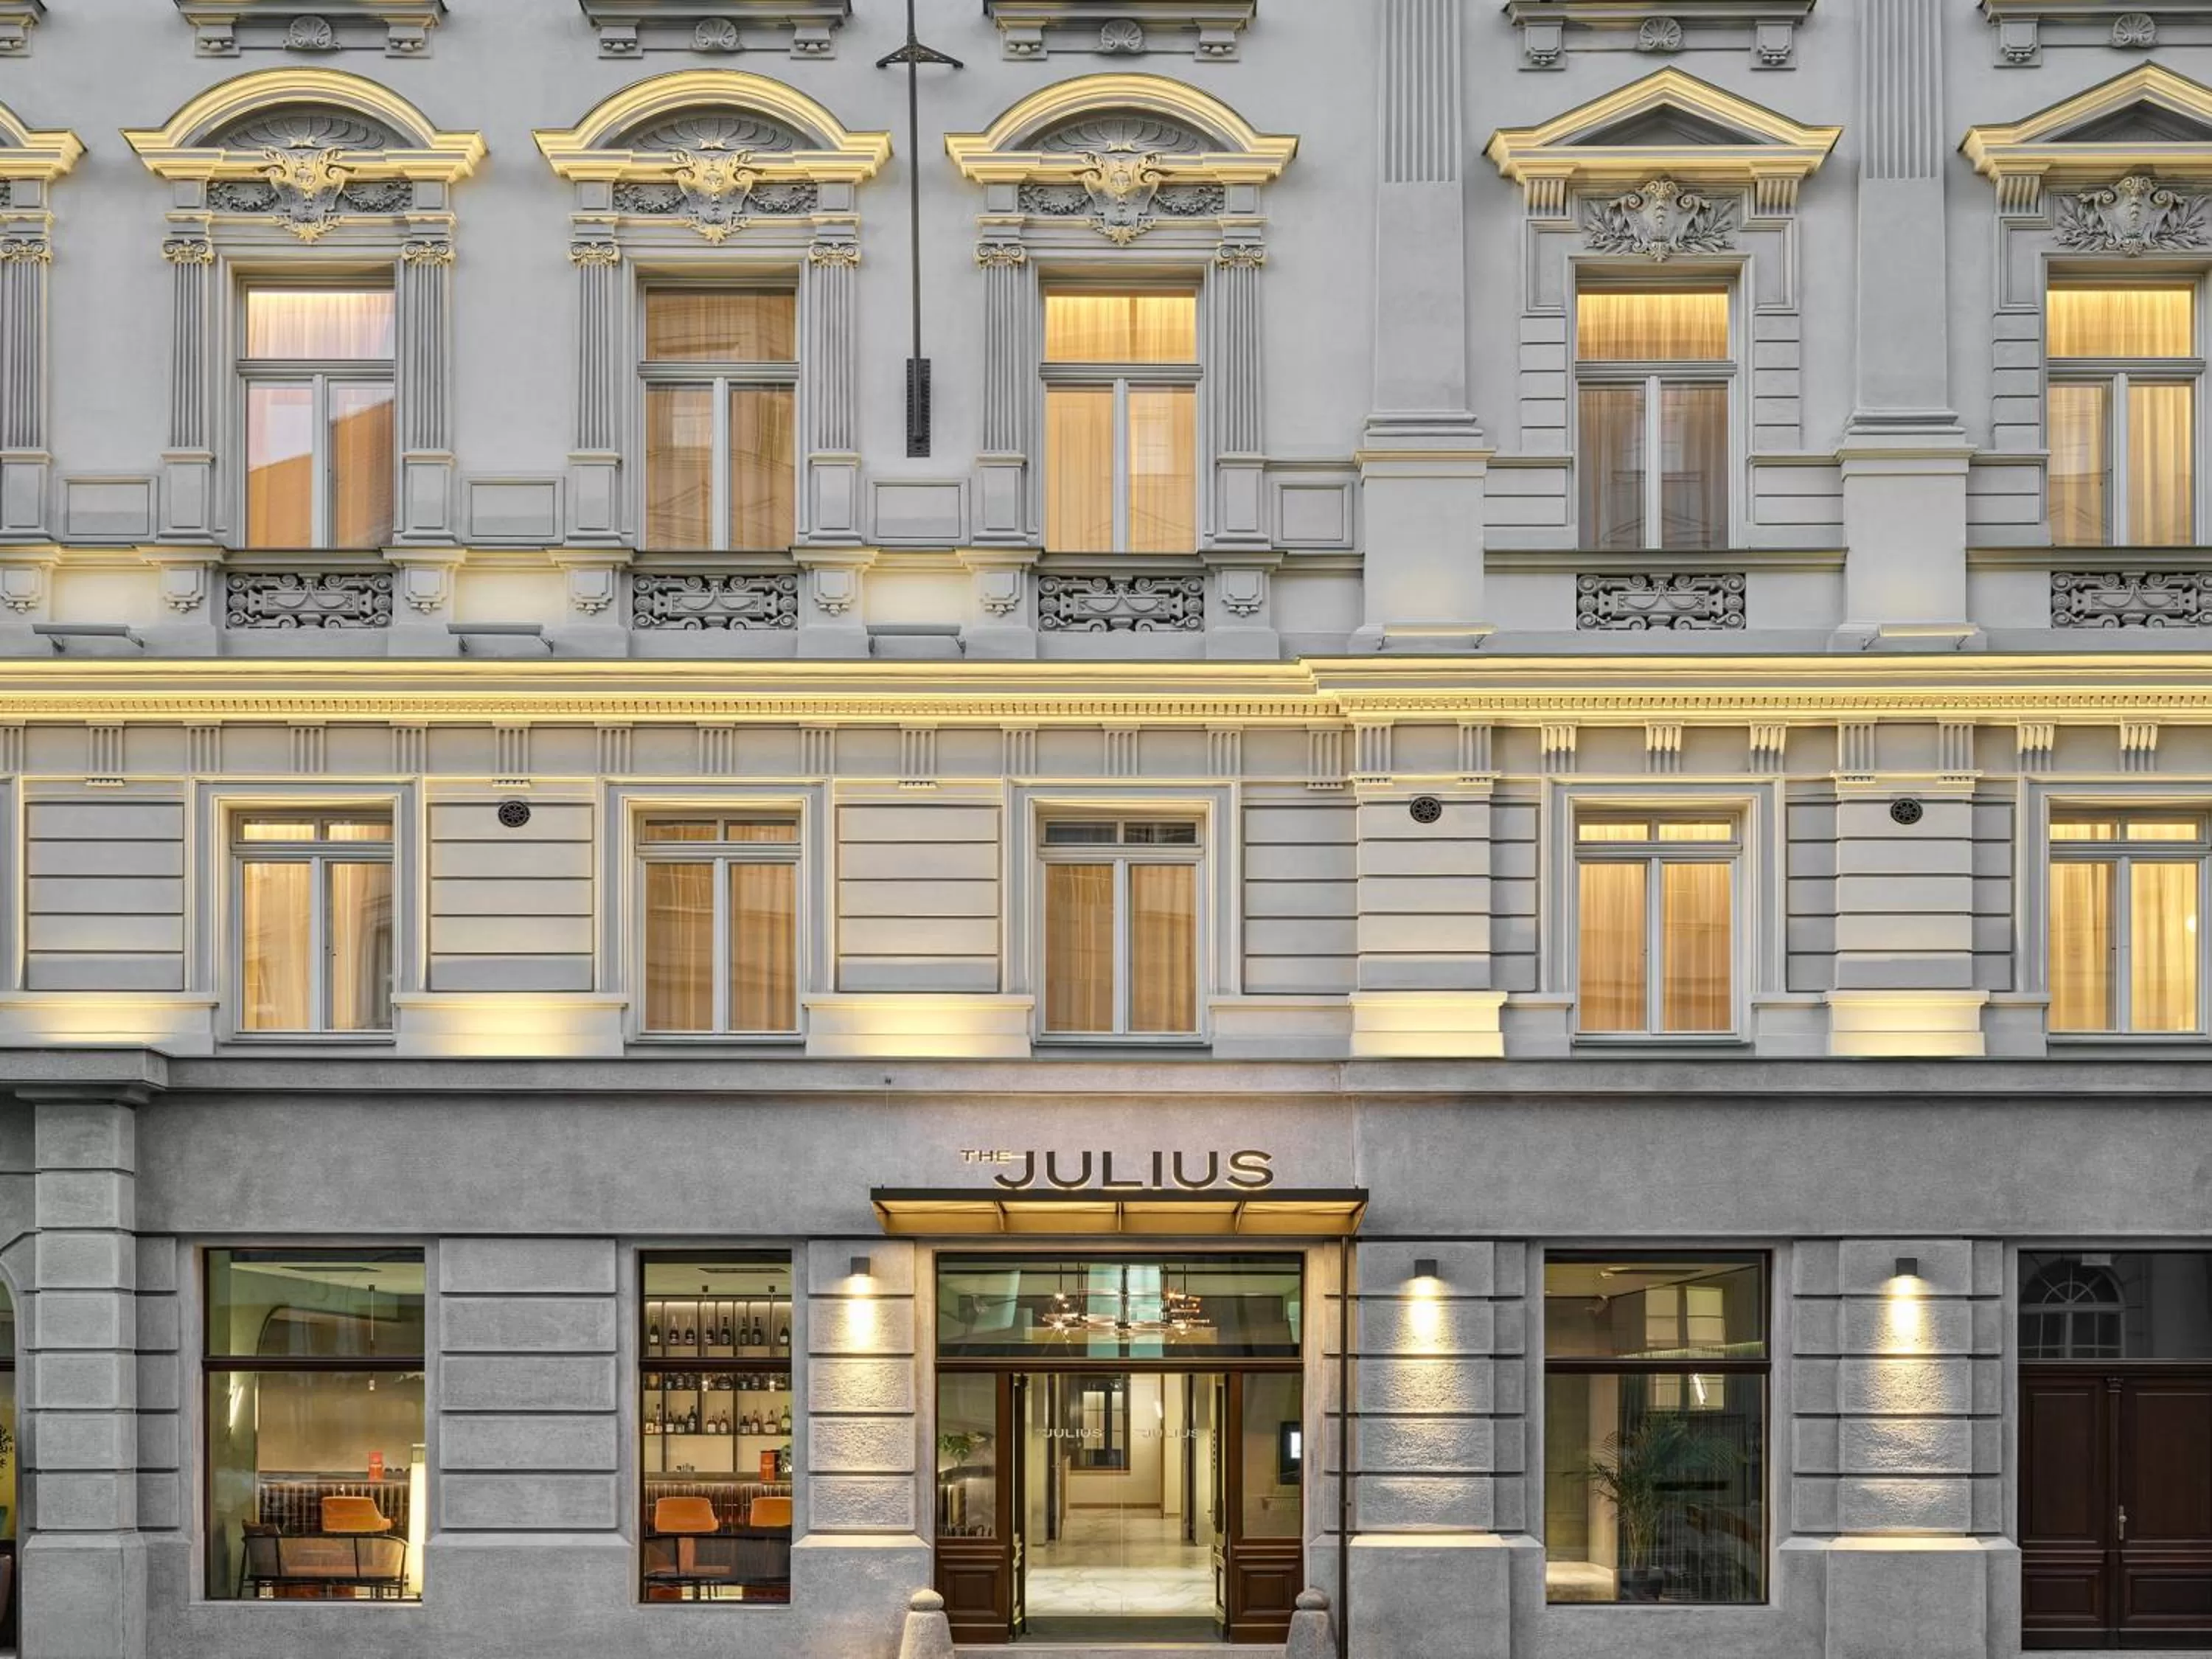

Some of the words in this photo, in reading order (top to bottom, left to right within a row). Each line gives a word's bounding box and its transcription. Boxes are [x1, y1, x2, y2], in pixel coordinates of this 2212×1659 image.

[961, 1150, 1012, 1163] THE
[994, 1150, 1274, 1189] JULIUS
[1043, 1428, 1103, 1438] JULIUS
